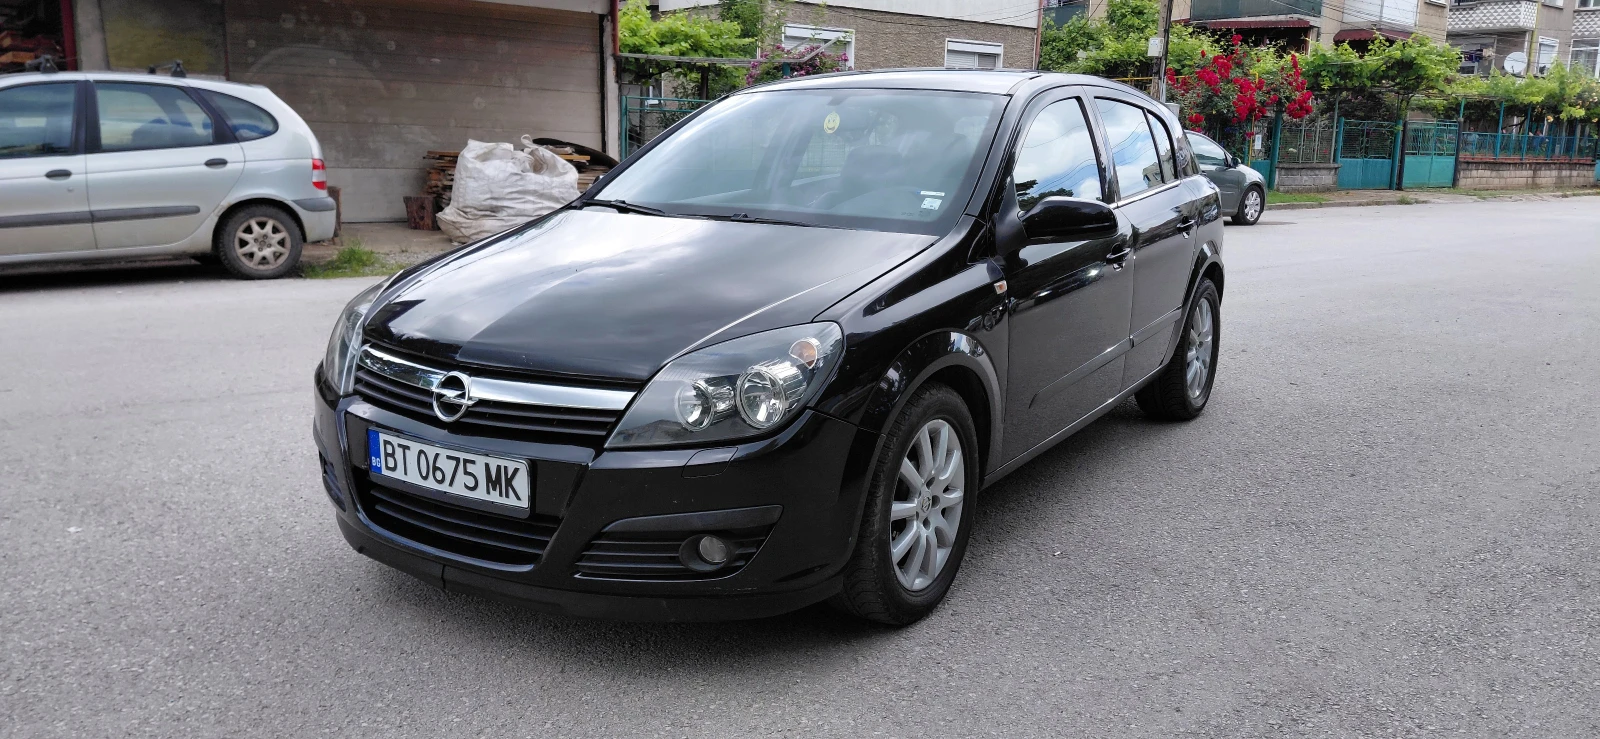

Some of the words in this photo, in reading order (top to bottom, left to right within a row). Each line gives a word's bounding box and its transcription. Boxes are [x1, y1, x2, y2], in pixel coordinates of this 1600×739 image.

[371, 456, 381, 468] BG
[383, 439, 411, 476] BT
[416, 448, 479, 492] 0675
[484, 462, 522, 501] MK
